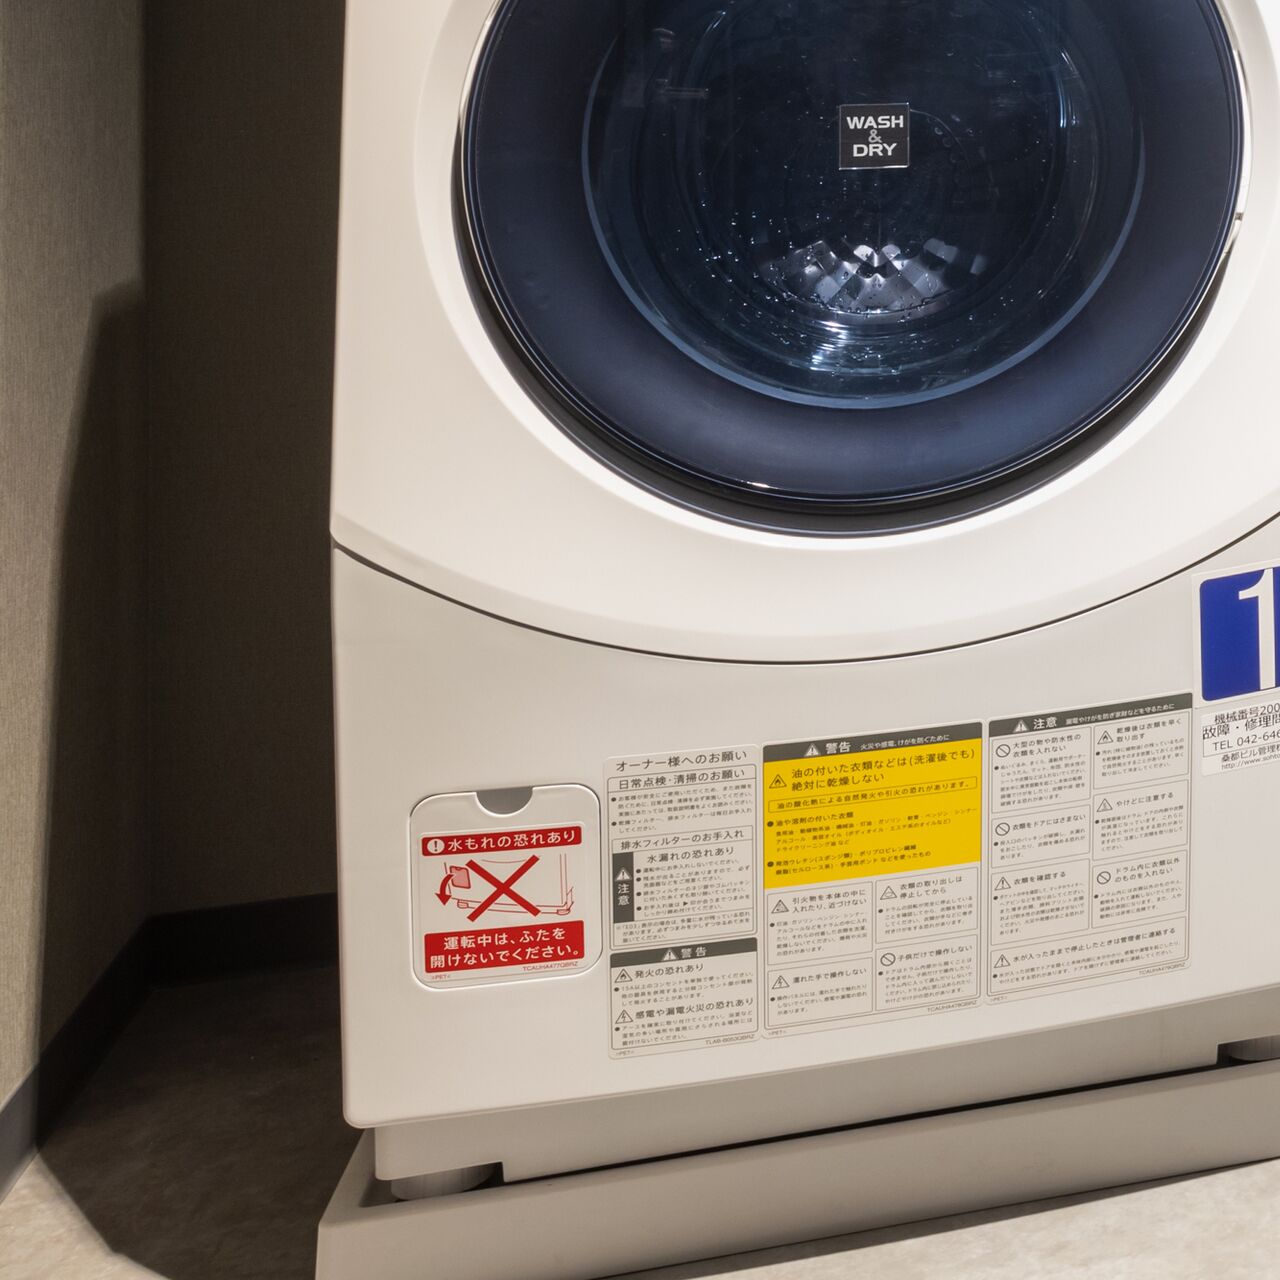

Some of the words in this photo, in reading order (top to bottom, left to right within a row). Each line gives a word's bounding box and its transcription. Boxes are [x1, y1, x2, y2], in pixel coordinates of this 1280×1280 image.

[846, 114, 904, 130] WASH
[868, 129, 882, 143] &
[852, 142, 898, 157] DRY
[1238, 568, 1276, 691] 1
[1033, 716, 1057, 730] 注意
[1013, 733, 1082, 749] 大型の物や防水性の
[1116, 732, 1145, 743] 取り出す
[1212, 739, 1233, 752] TEL
[825, 740, 851, 754] 警告
[1013, 744, 1067, 758] 衣類を入れない
[616, 750, 748, 772] オーナー様へのお願い
[619, 769, 745, 790] 日常点検・清掃のお願い
[791, 773, 885, 792] 絶対に乾燥しない
[1116, 791, 1174, 807] やけどに注意する
[1013, 814, 1086, 831] 衣類をドアにはさまない
[448, 829, 576, 852] 水もれの恐れあり
[621, 830, 744, 851] 排水フィルターのお手入れ
[647, 846, 735, 863] 水漏れの恐れあり
[900, 875, 963, 891] 衣類の取り出しは
[1014, 870, 1067, 885] 衣類を確認する
[1115, 867, 1174, 883] のものを入れない
[617, 883, 630, 906] 注意
[900, 886, 946, 900] 停止してから
[443, 927, 566, 951] 運転中は、ふたを
[430, 944, 579, 969] 開けないでください。
[681, 946, 708, 958] 警告
[899, 944, 973, 962] 子供だけで操作しない
[635, 963, 704, 979] 発火の恐れあり
[793, 967, 867, 984] 濡れた手で操作しない
[635, 998, 754, 1019] 感電や漏電火災の恐れあり
